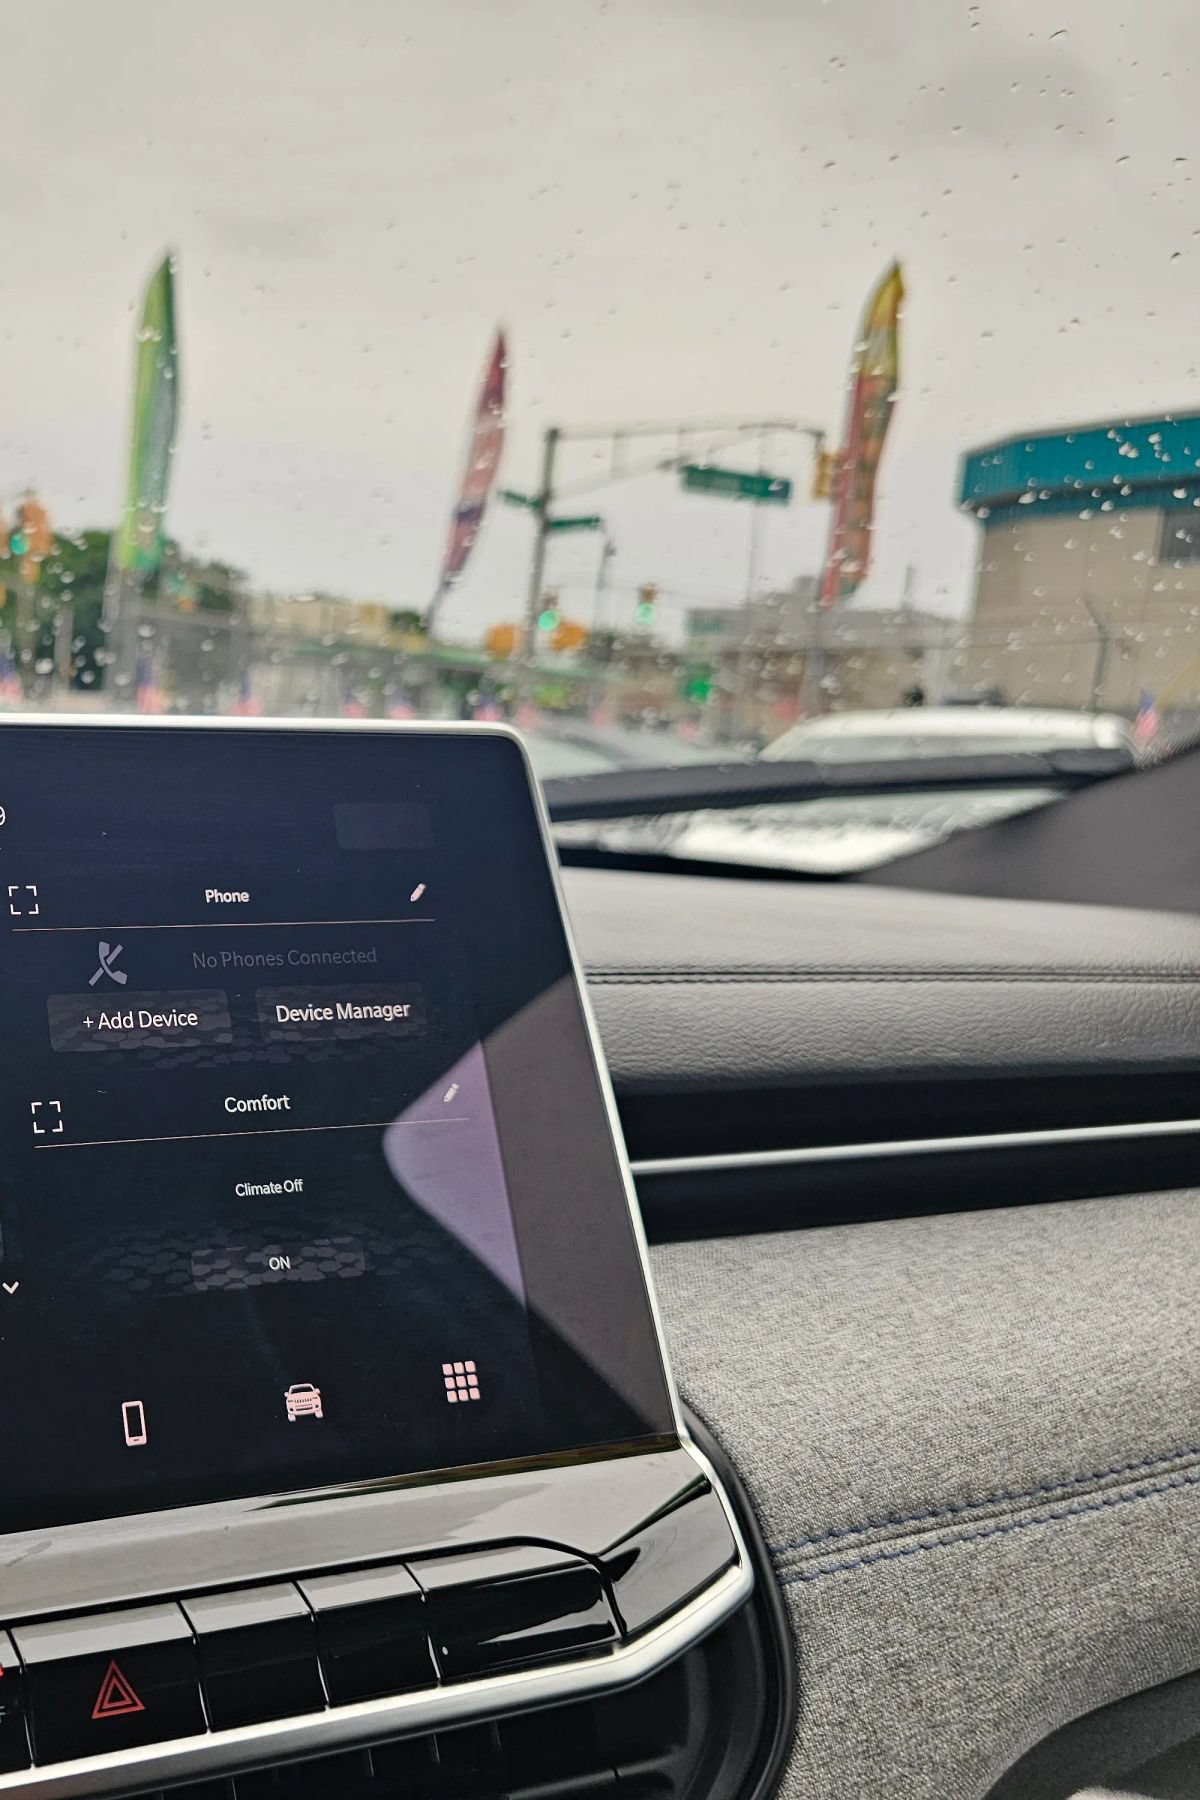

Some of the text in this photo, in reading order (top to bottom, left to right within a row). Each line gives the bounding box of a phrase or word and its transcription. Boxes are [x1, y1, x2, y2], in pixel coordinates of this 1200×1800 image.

[204, 888, 250, 904] Phone
[192, 946, 378, 969] No Phones Connected
[98, 1010, 134, 1030] Add
[138, 1008, 198, 1029] Device
[275, 1001, 411, 1026] Device Manager
[224, 1094, 291, 1114] Comfort
[235, 1178, 304, 1198] Climate Off
[268, 1255, 291, 1272] ON
